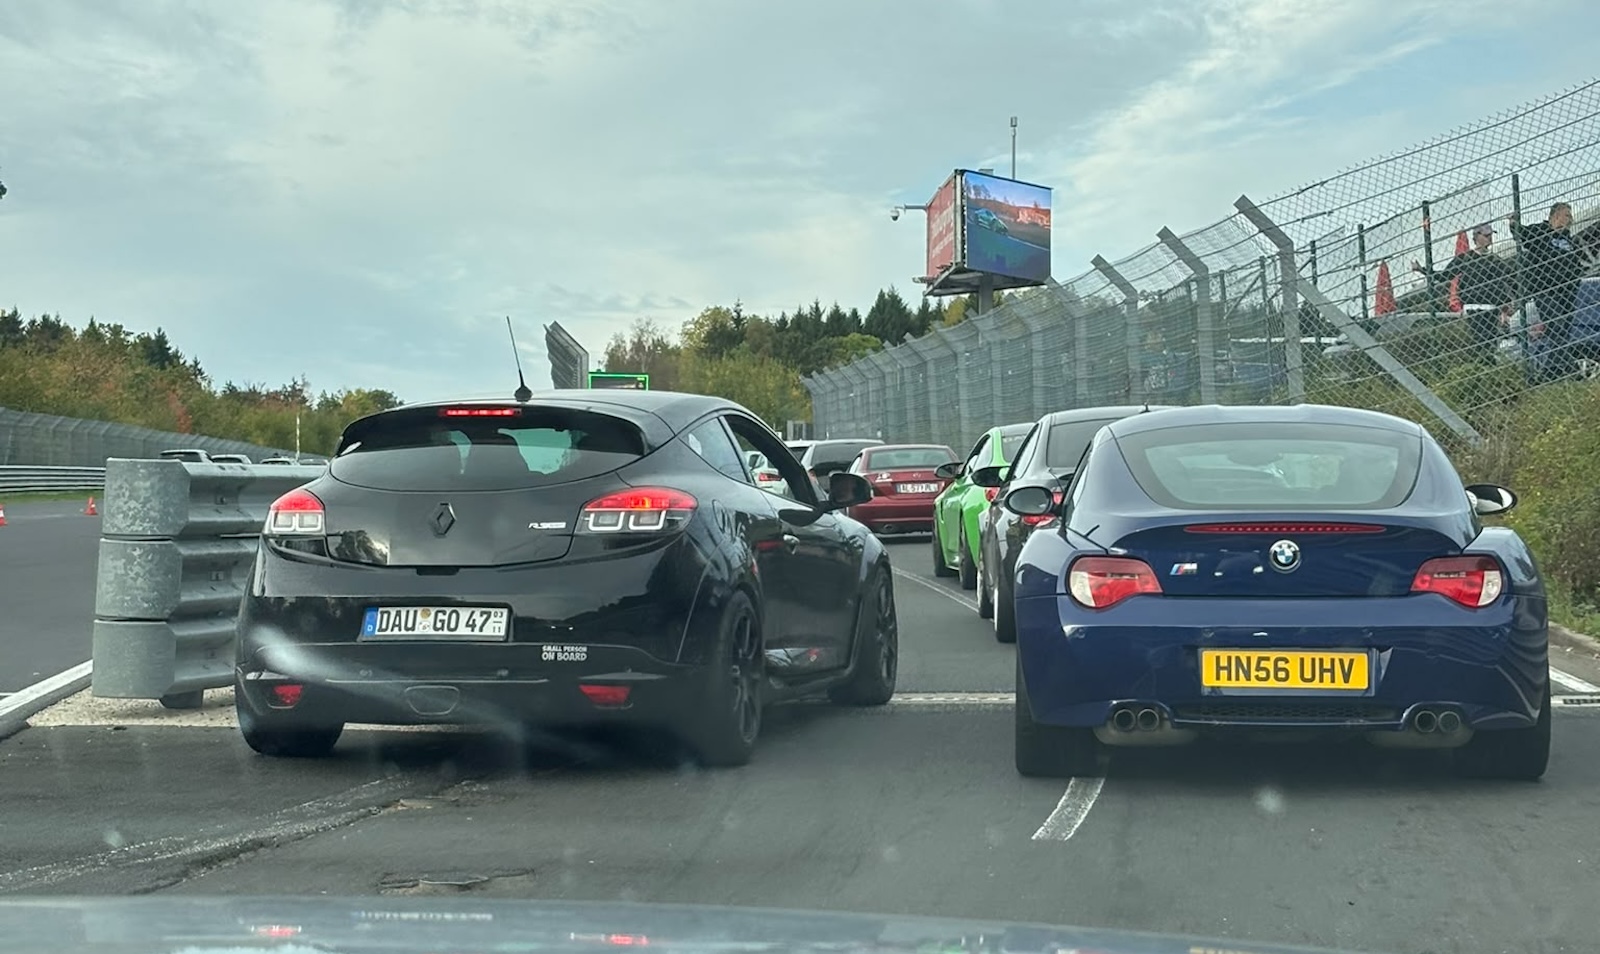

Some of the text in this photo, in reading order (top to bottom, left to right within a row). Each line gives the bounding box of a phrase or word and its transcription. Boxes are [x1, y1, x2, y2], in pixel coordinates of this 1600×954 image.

[377, 609, 492, 633] DAU GO 47
[541, 651, 588, 661] ON BOARD
[1215, 655, 1355, 684] HN56 UHV
